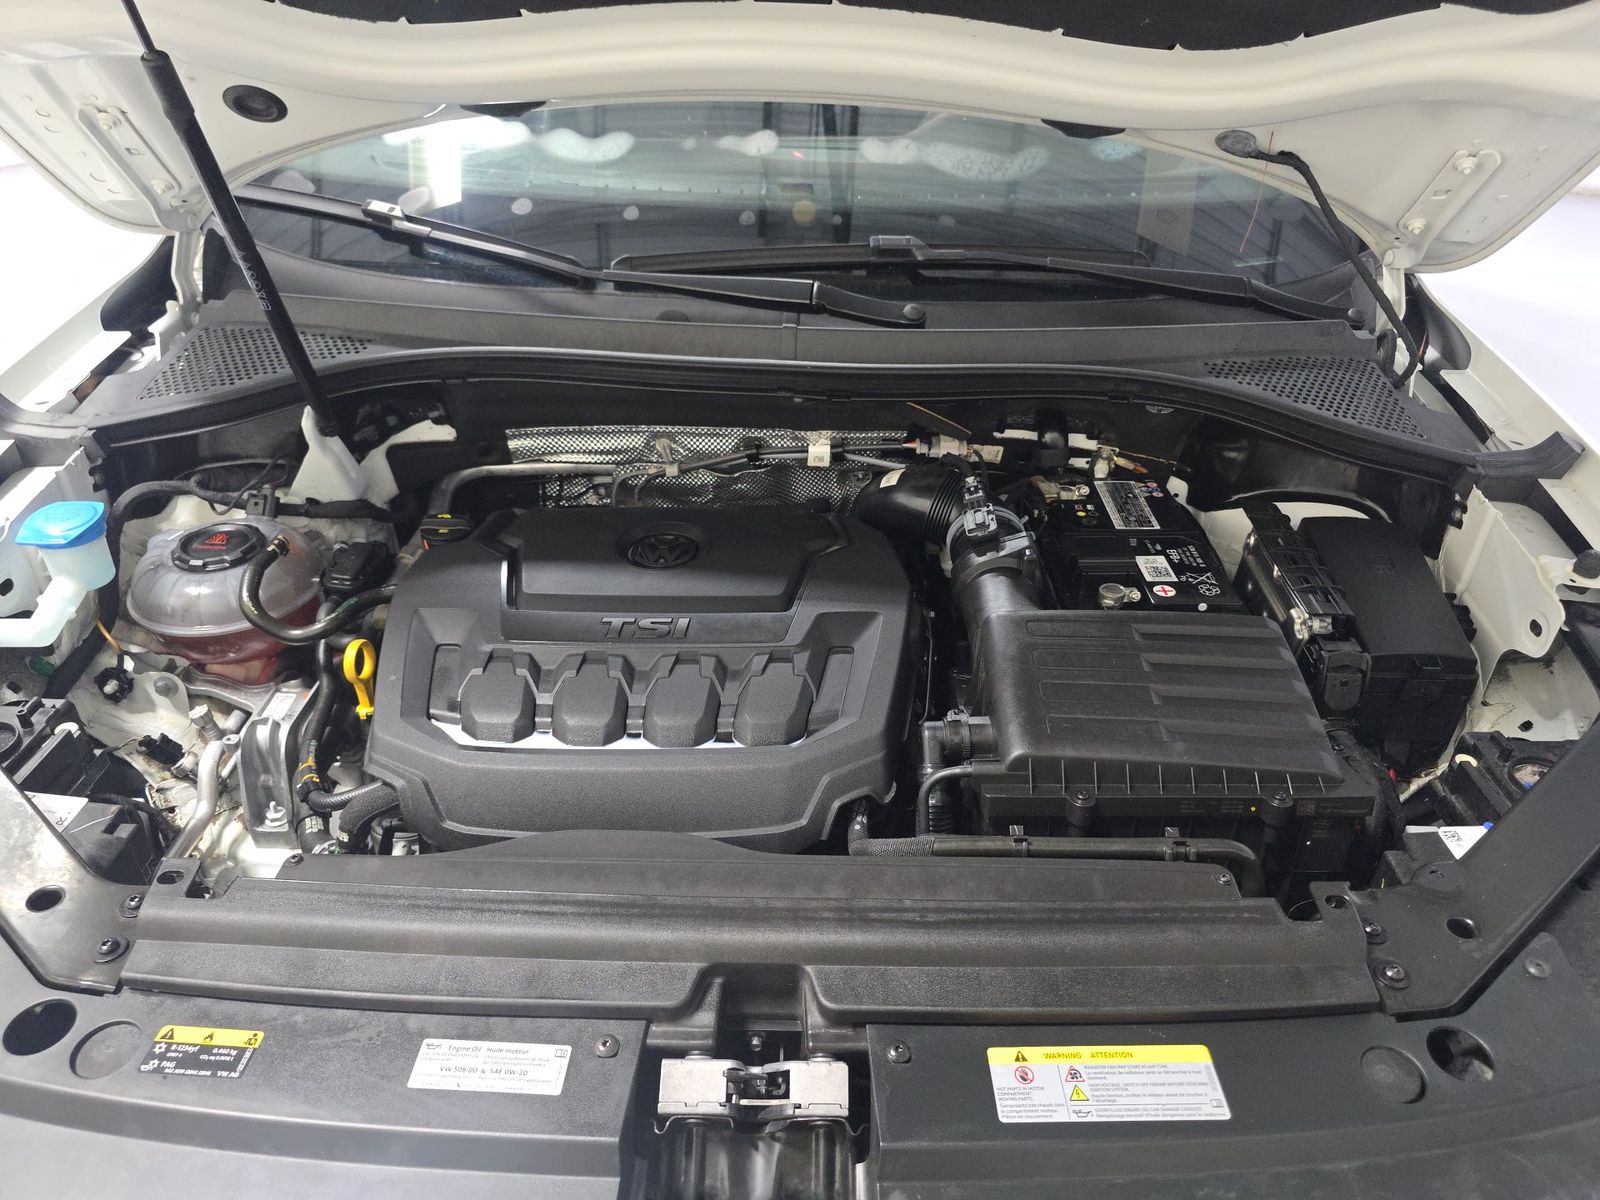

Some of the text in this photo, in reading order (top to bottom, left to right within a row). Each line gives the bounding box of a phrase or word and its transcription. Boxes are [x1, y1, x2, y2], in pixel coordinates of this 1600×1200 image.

[1166, 549, 1181, 563] EFB+
[600, 617, 691, 640] TSI
[448, 1044, 471, 1053] Engine
[1090, 1051, 1134, 1059] ATTENTION
